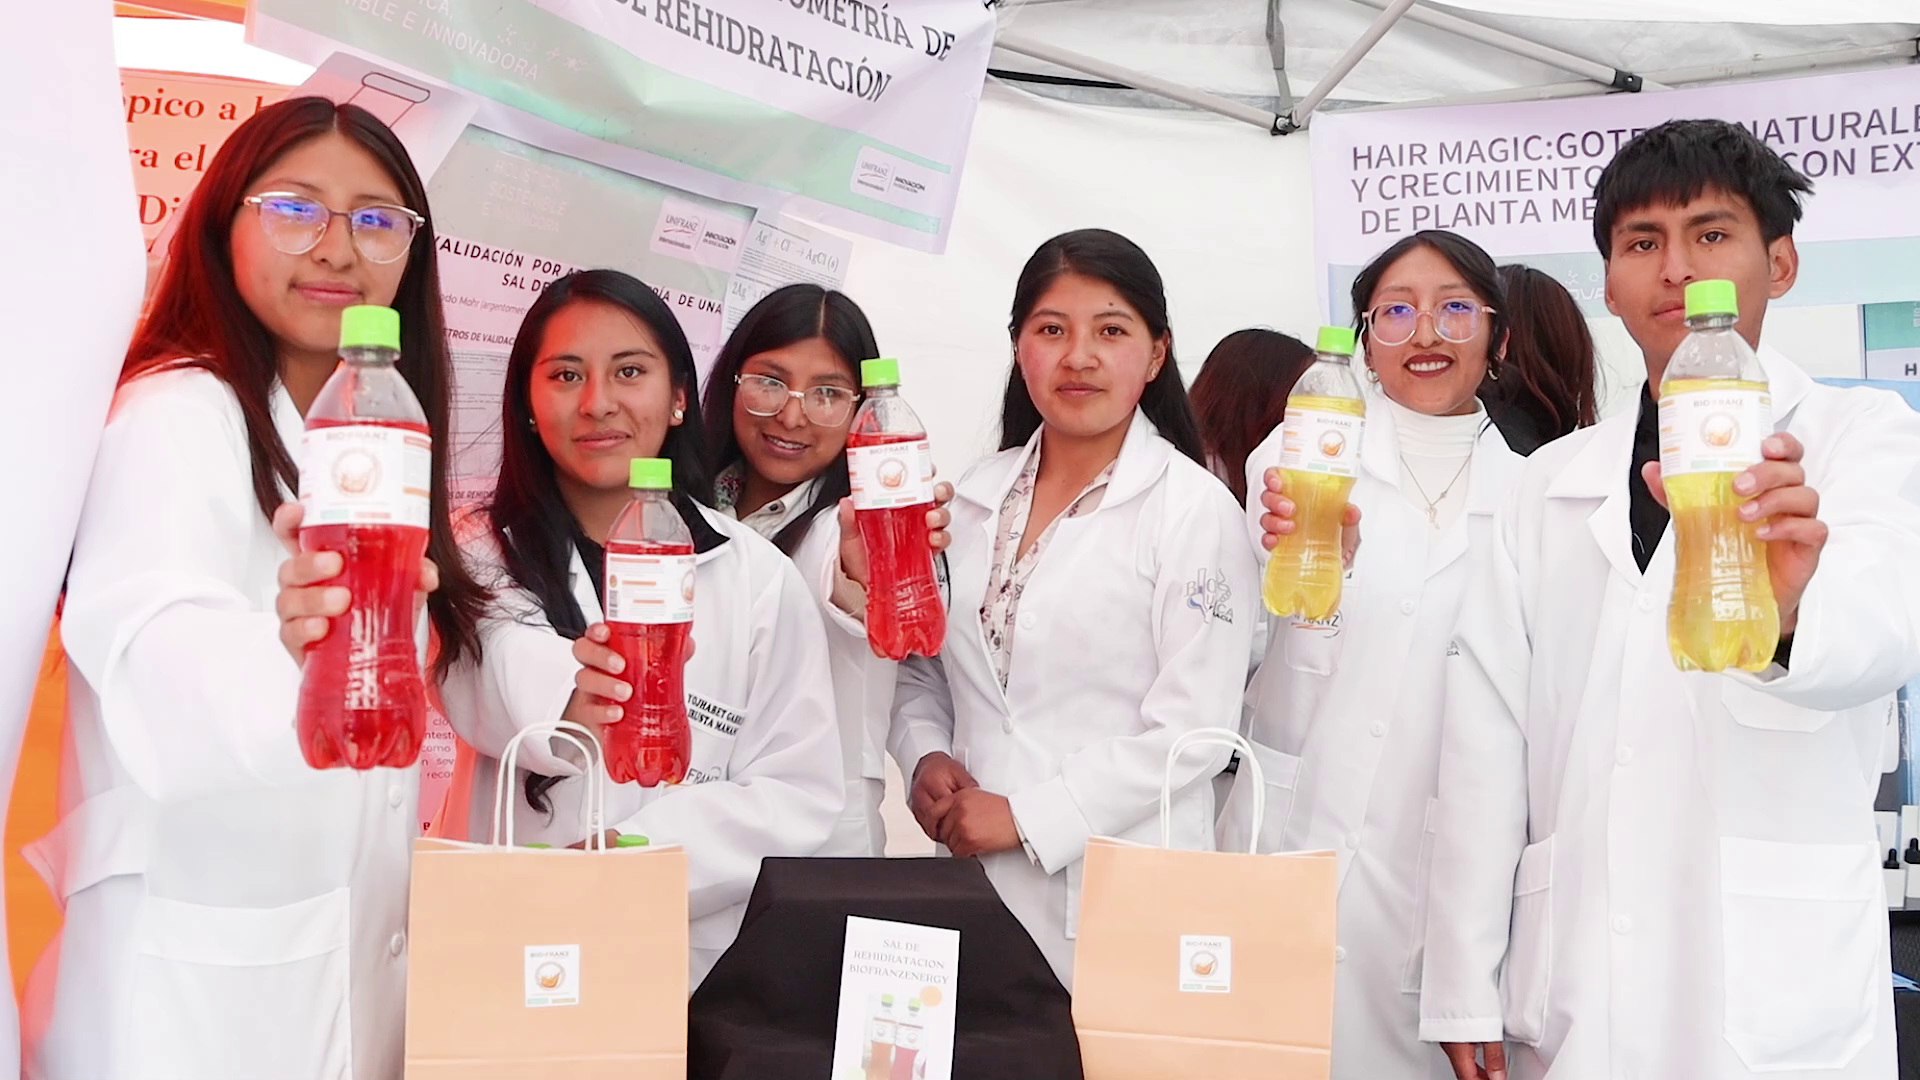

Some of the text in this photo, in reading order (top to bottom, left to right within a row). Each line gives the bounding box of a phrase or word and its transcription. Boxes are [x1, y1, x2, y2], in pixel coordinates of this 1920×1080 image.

[402, 11, 418, 30] E
[422, 18, 538, 80] INNOVADORA
[655, 0, 891, 102] REHIDRATACIÓN
[921, 25, 955, 62] DE
[122, 86, 204, 123] pico
[218, 101, 237, 120] a
[174, 144, 207, 172] el
[1353, 143, 1427, 171] HAIR
[1351, 177, 1369, 203] Y
[1378, 165, 1604, 200] CRECIMIENTO
[1361, 208, 1400, 235] DE
[1412, 199, 1541, 231] PLANTA
[501, 273, 525, 289] SAL
[532, 259, 562, 277] POR
[678, 294, 695, 308] DE
[698, 299, 722, 315] UNA
[470, 332, 481, 342] DE
[688, 693, 727, 719] YOJHABET
[853, 949, 945, 969] REHIDRATACION
[883, 939, 920, 952] SAL DE
[849, 964, 949, 985] BIOFRANZENERGY
